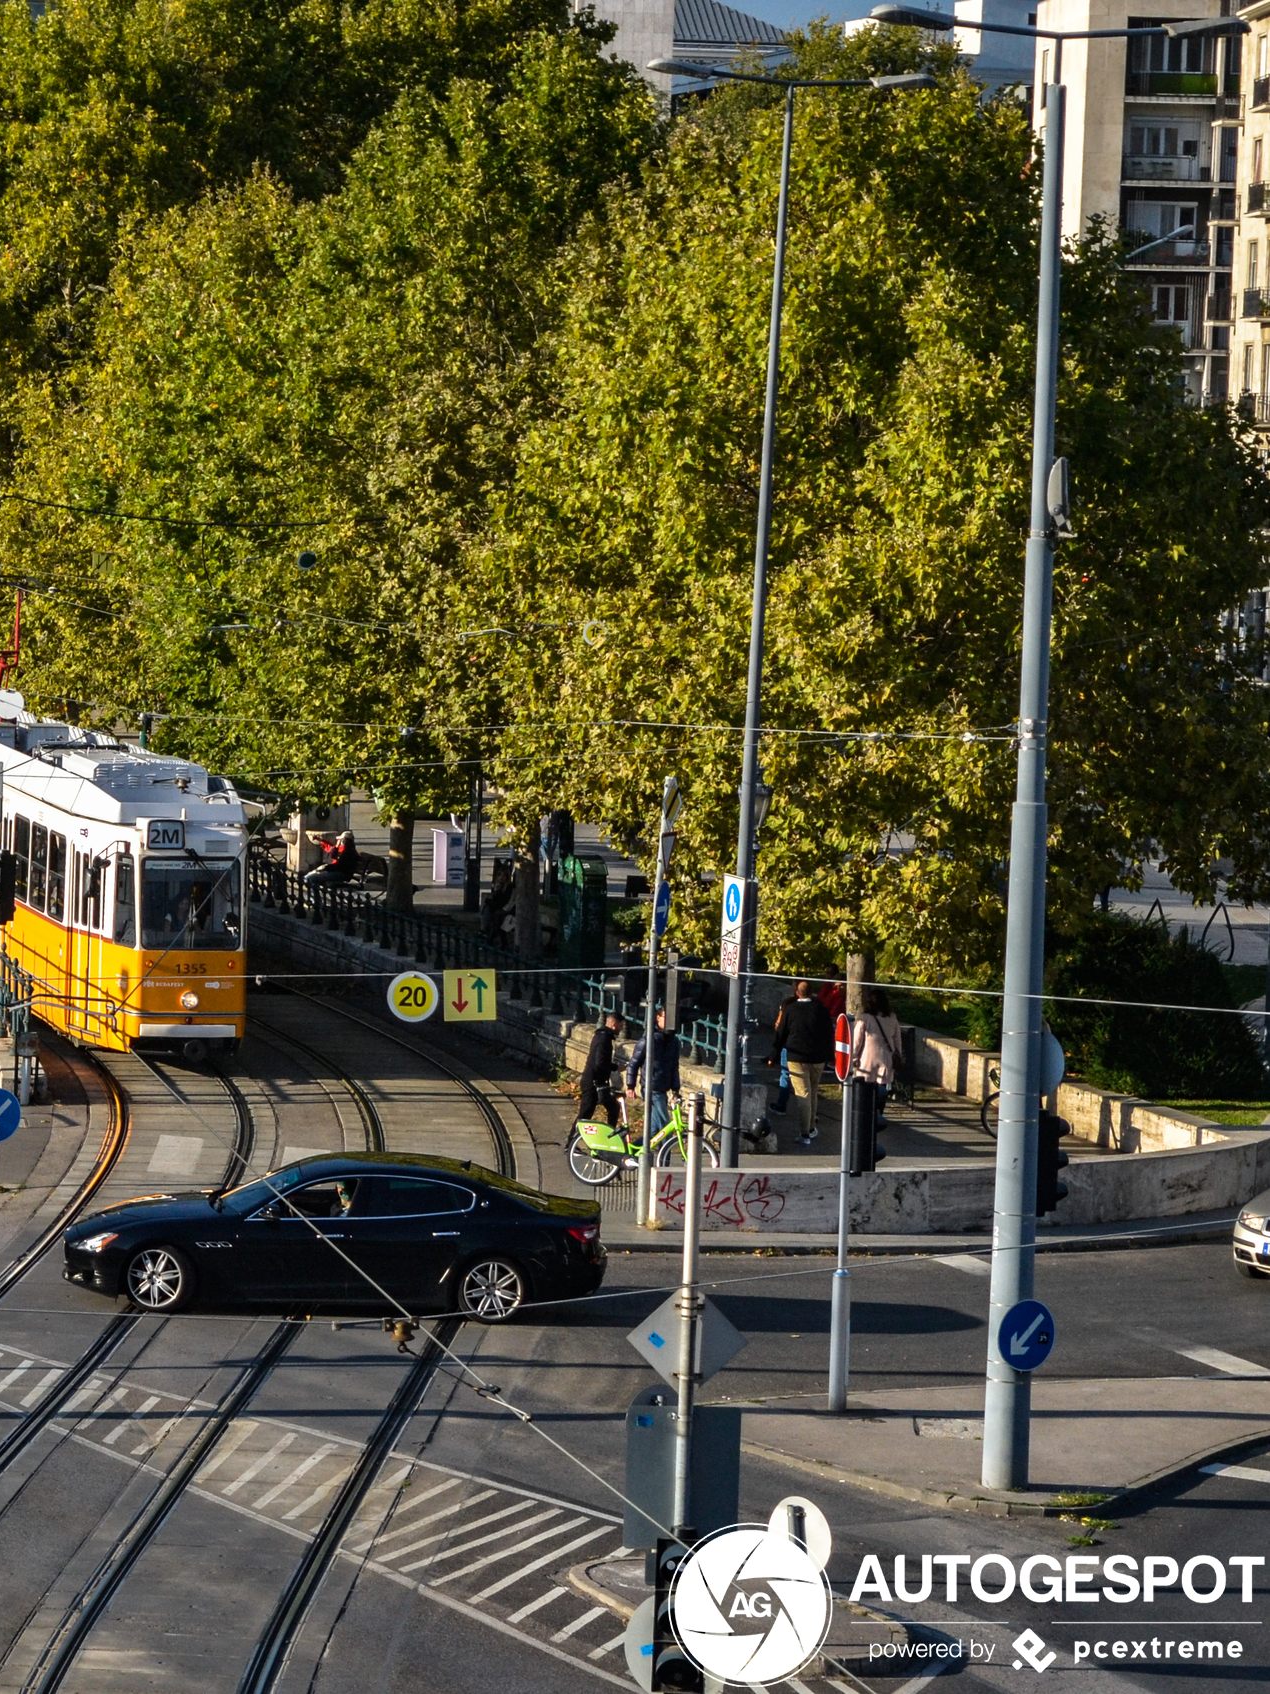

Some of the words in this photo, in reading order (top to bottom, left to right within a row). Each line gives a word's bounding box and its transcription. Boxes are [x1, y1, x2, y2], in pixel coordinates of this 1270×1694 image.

[150, 829, 180, 844] 2M
[182, 861, 197, 869] 2M
[175, 963, 207, 974] 1355
[398, 986, 427, 1007] 20
